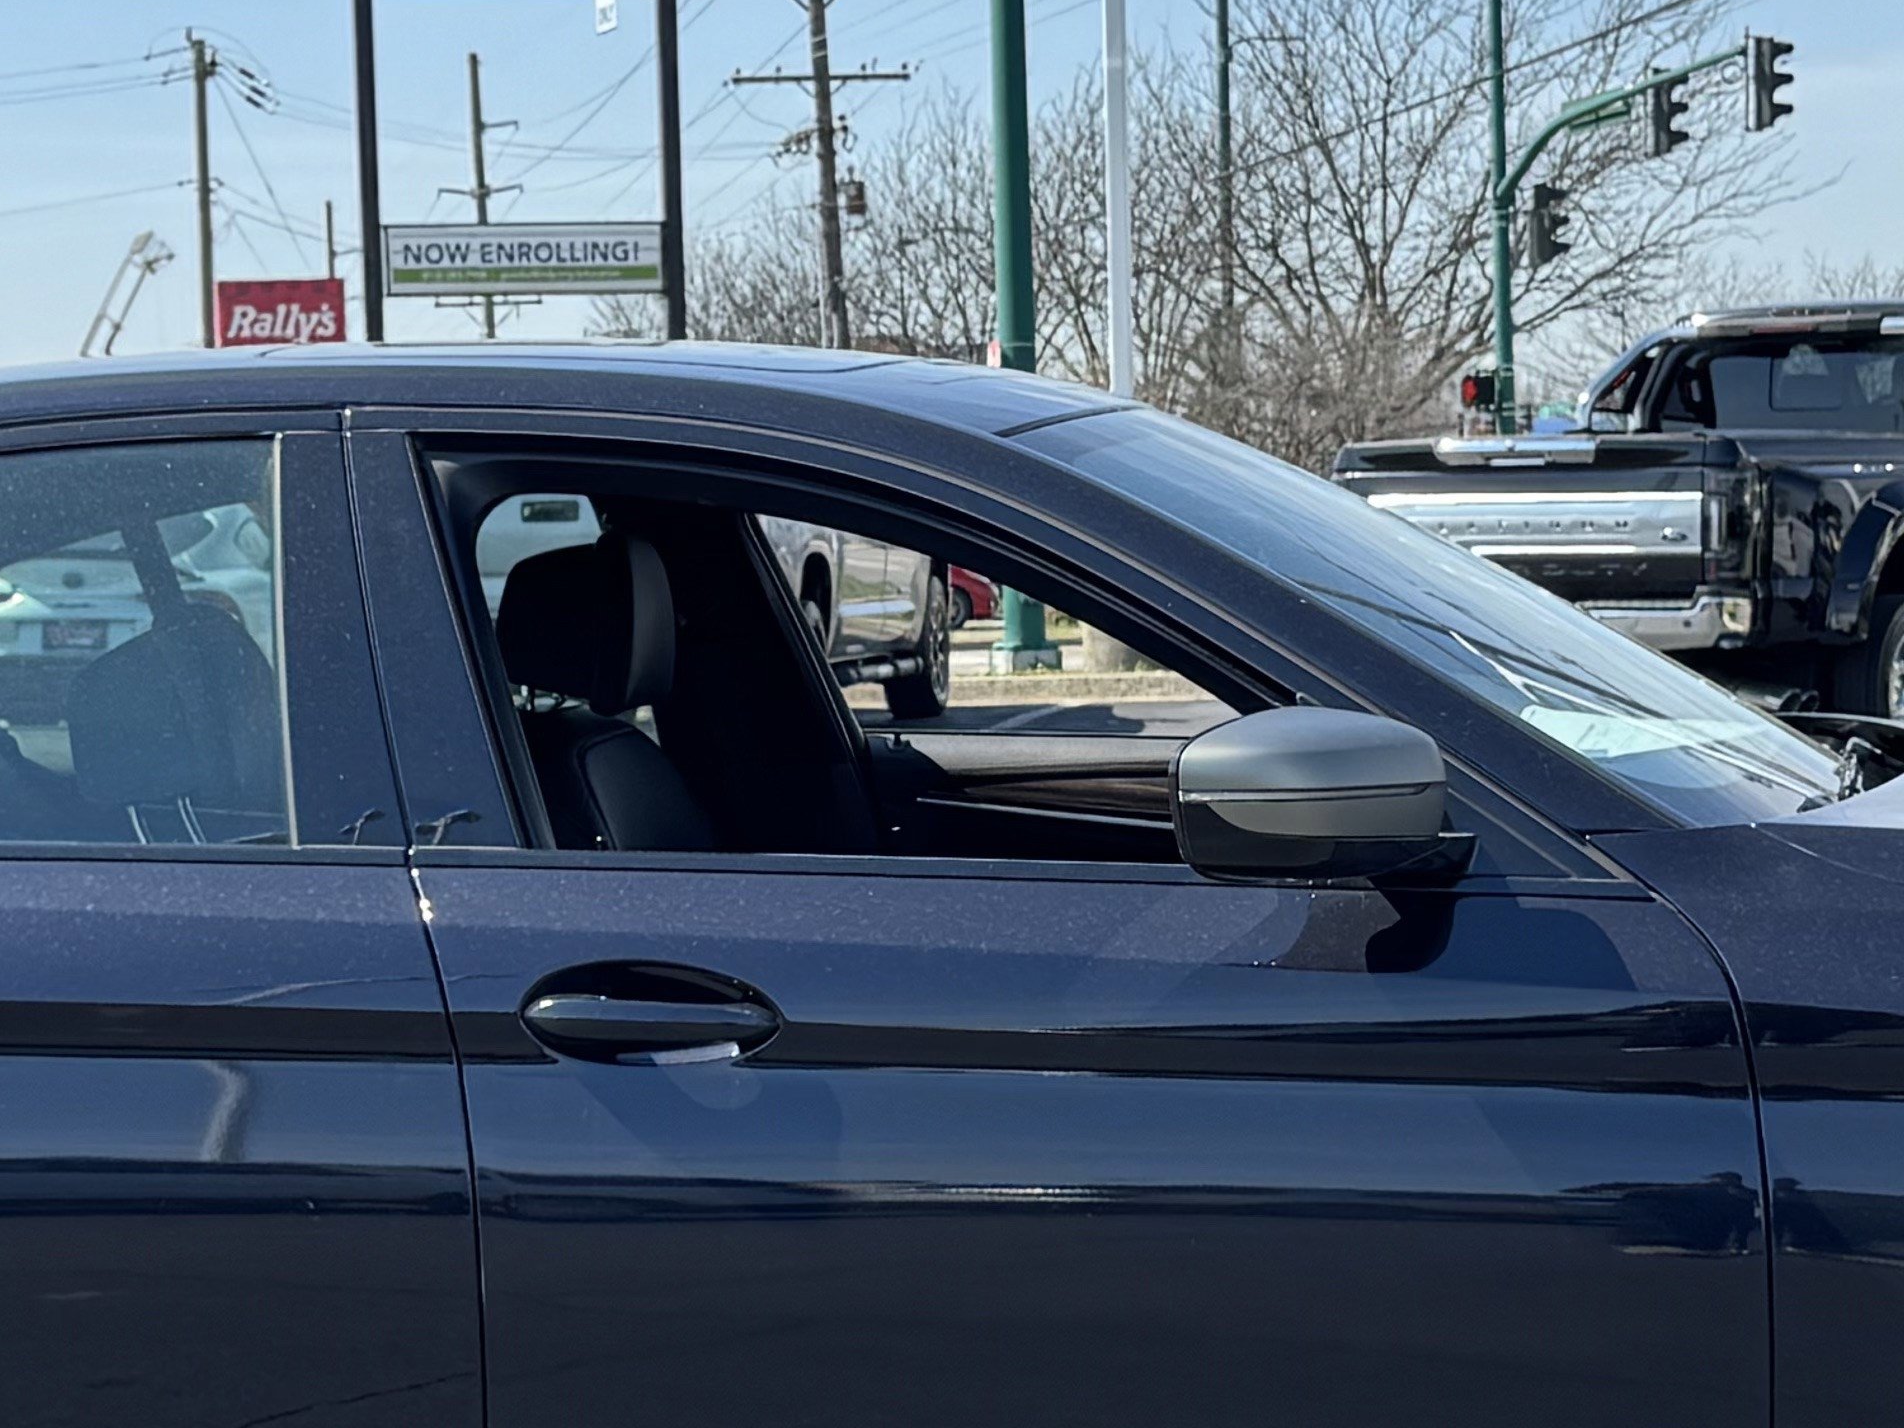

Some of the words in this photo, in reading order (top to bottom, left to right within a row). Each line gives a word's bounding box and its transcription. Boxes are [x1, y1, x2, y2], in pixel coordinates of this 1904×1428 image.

[402, 242, 471, 266] NOW
[480, 240, 640, 265] ENROLLING!
[227, 303, 337, 344] Rally's
